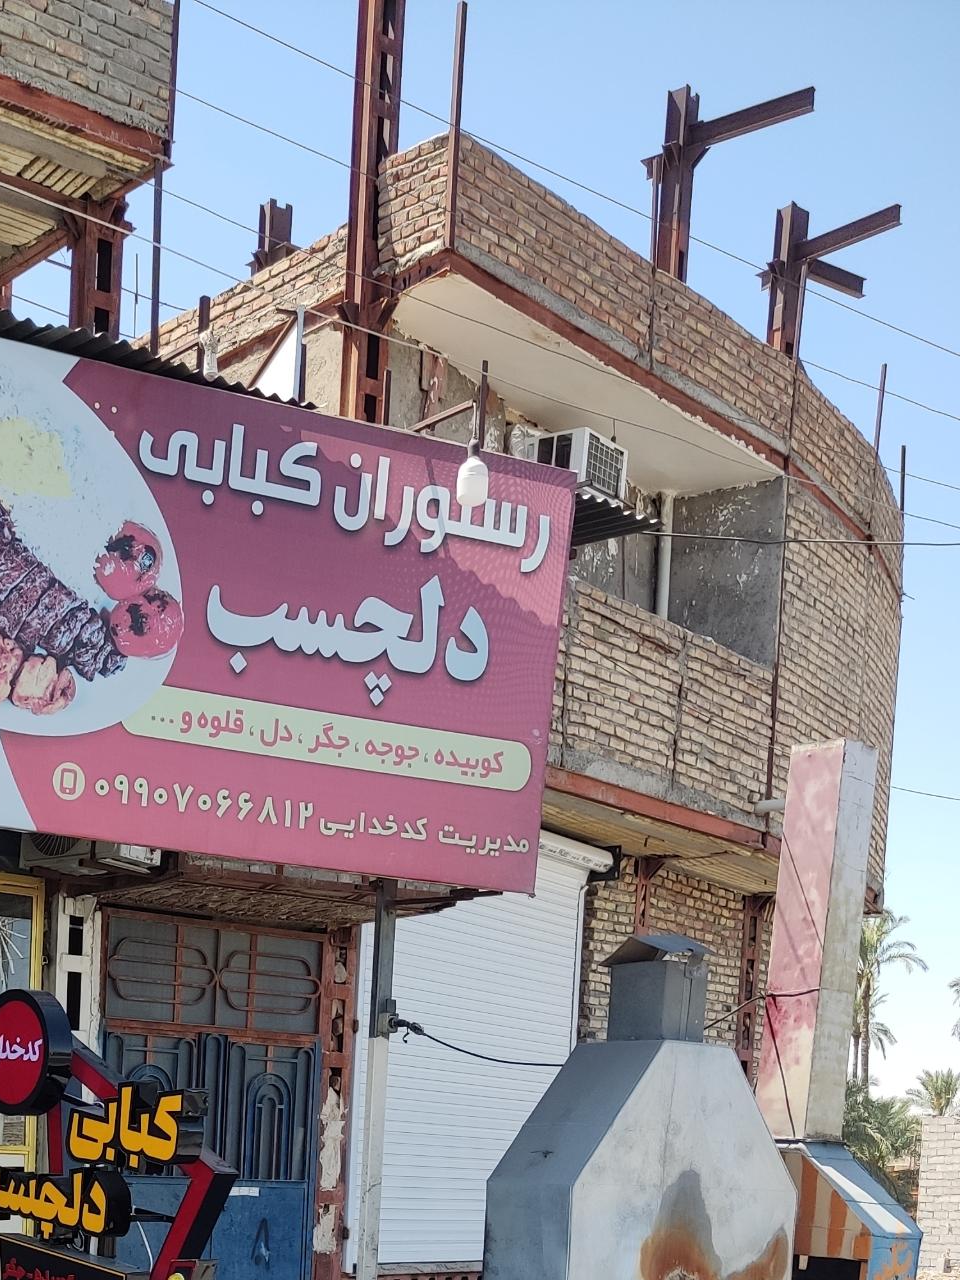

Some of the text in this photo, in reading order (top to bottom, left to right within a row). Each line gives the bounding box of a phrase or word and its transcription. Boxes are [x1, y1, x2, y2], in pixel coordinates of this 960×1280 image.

[138, 423, 323, 516] کبابی
[206, 575, 489, 706] دلچسب
[197, 709, 245, 738] قلوه
[95, 774, 314, 830] ۰۹۹۰۷۰۶۶۸۱۲
[318, 811, 428, 841] کدخدایی
[437, 823, 531, 858] مدیریت
[70, 1085, 183, 1168] کبابی
